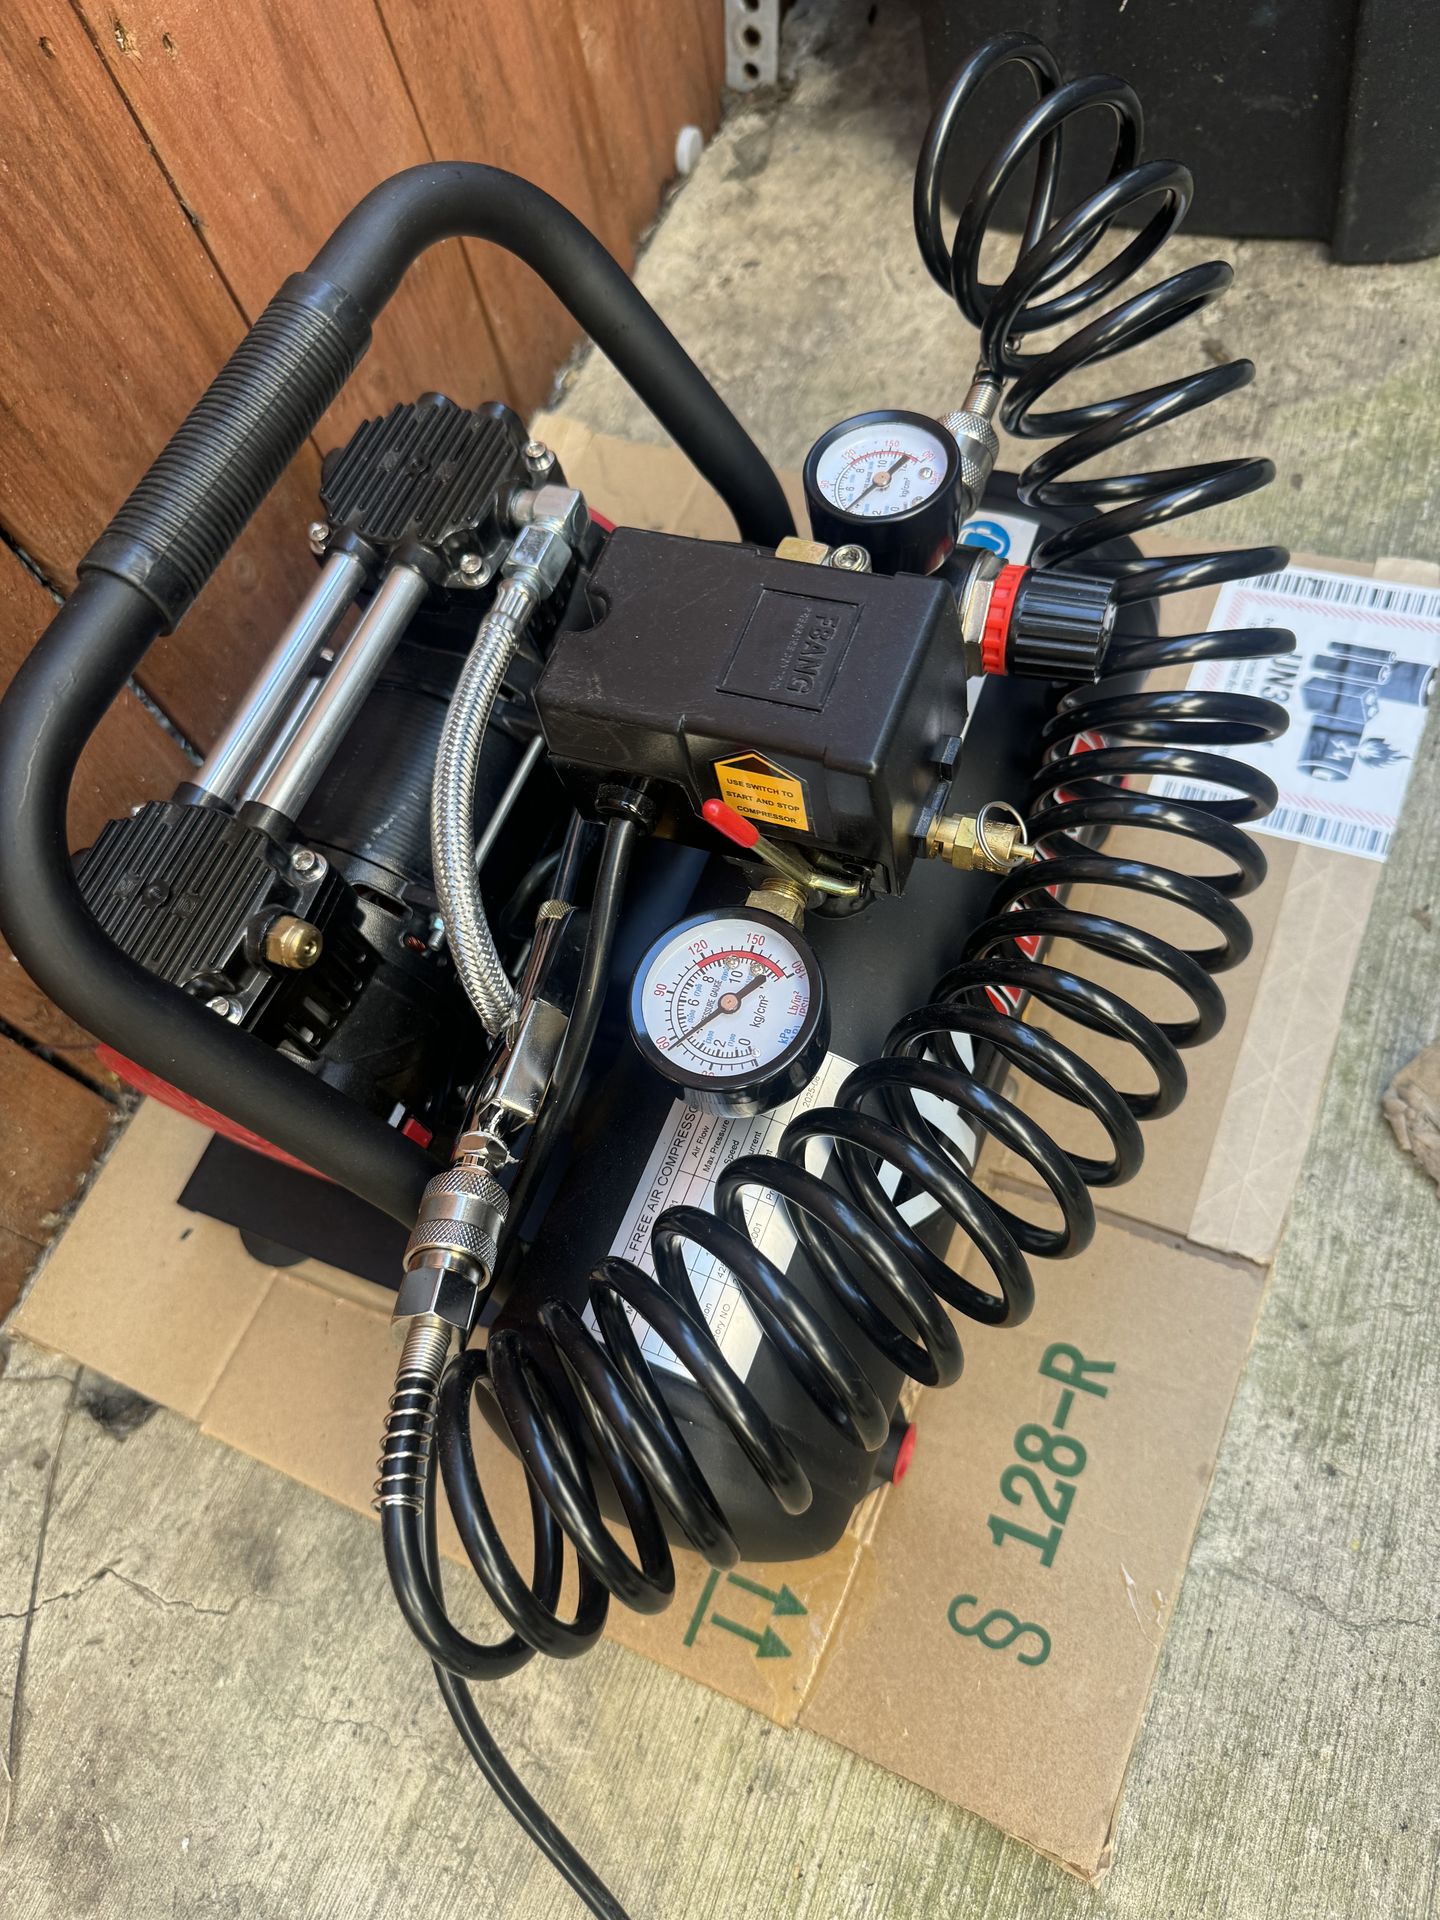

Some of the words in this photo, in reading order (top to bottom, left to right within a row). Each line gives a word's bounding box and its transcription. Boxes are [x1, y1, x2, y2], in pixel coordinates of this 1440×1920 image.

[878, 460, 888, 468] 10
[726, 778, 745, 787] USE
[746, 783, 780, 795] SWITCH
[782, 790, 794, 798] TO
[726, 790, 753, 802] START
[756, 798, 774, 806] AND
[777, 802, 800, 812] STOP
[736, 805, 797, 824] COMPRESSOR
[688, 940, 709, 956] 120
[746, 932, 766, 946] 150
[729, 970, 744, 984] 10
[792, 960, 807, 979] 180
[702, 975, 714, 984] 8
[654, 983, 668, 997] 90
[688, 998, 700, 1007] 6
[749, 994, 769, 1028] kg/cm²
[655, 1035, 670, 1050] 60
[713, 1039, 726, 1048] 2
[738, 1038, 752, 1046] 0
[777, 1027, 792, 1046] kPa
[691, 1148, 701, 1159] Air
[697, 1125, 710, 1147] Flow
[702, 1155, 714, 1173] Max
[710, 1119, 730, 1154] Pressure
[748, 1131, 762, 1155] urrent
[724, 1140, 740, 1165] Speed
[629, 1214, 653, 1252] FREE
[648, 1189, 664, 1213] AIR
[657, 1101, 700, 1186] COMPRESSO
[720, 1303, 731, 1319] NO
[986, 1341, 1117, 1569] 128-R
